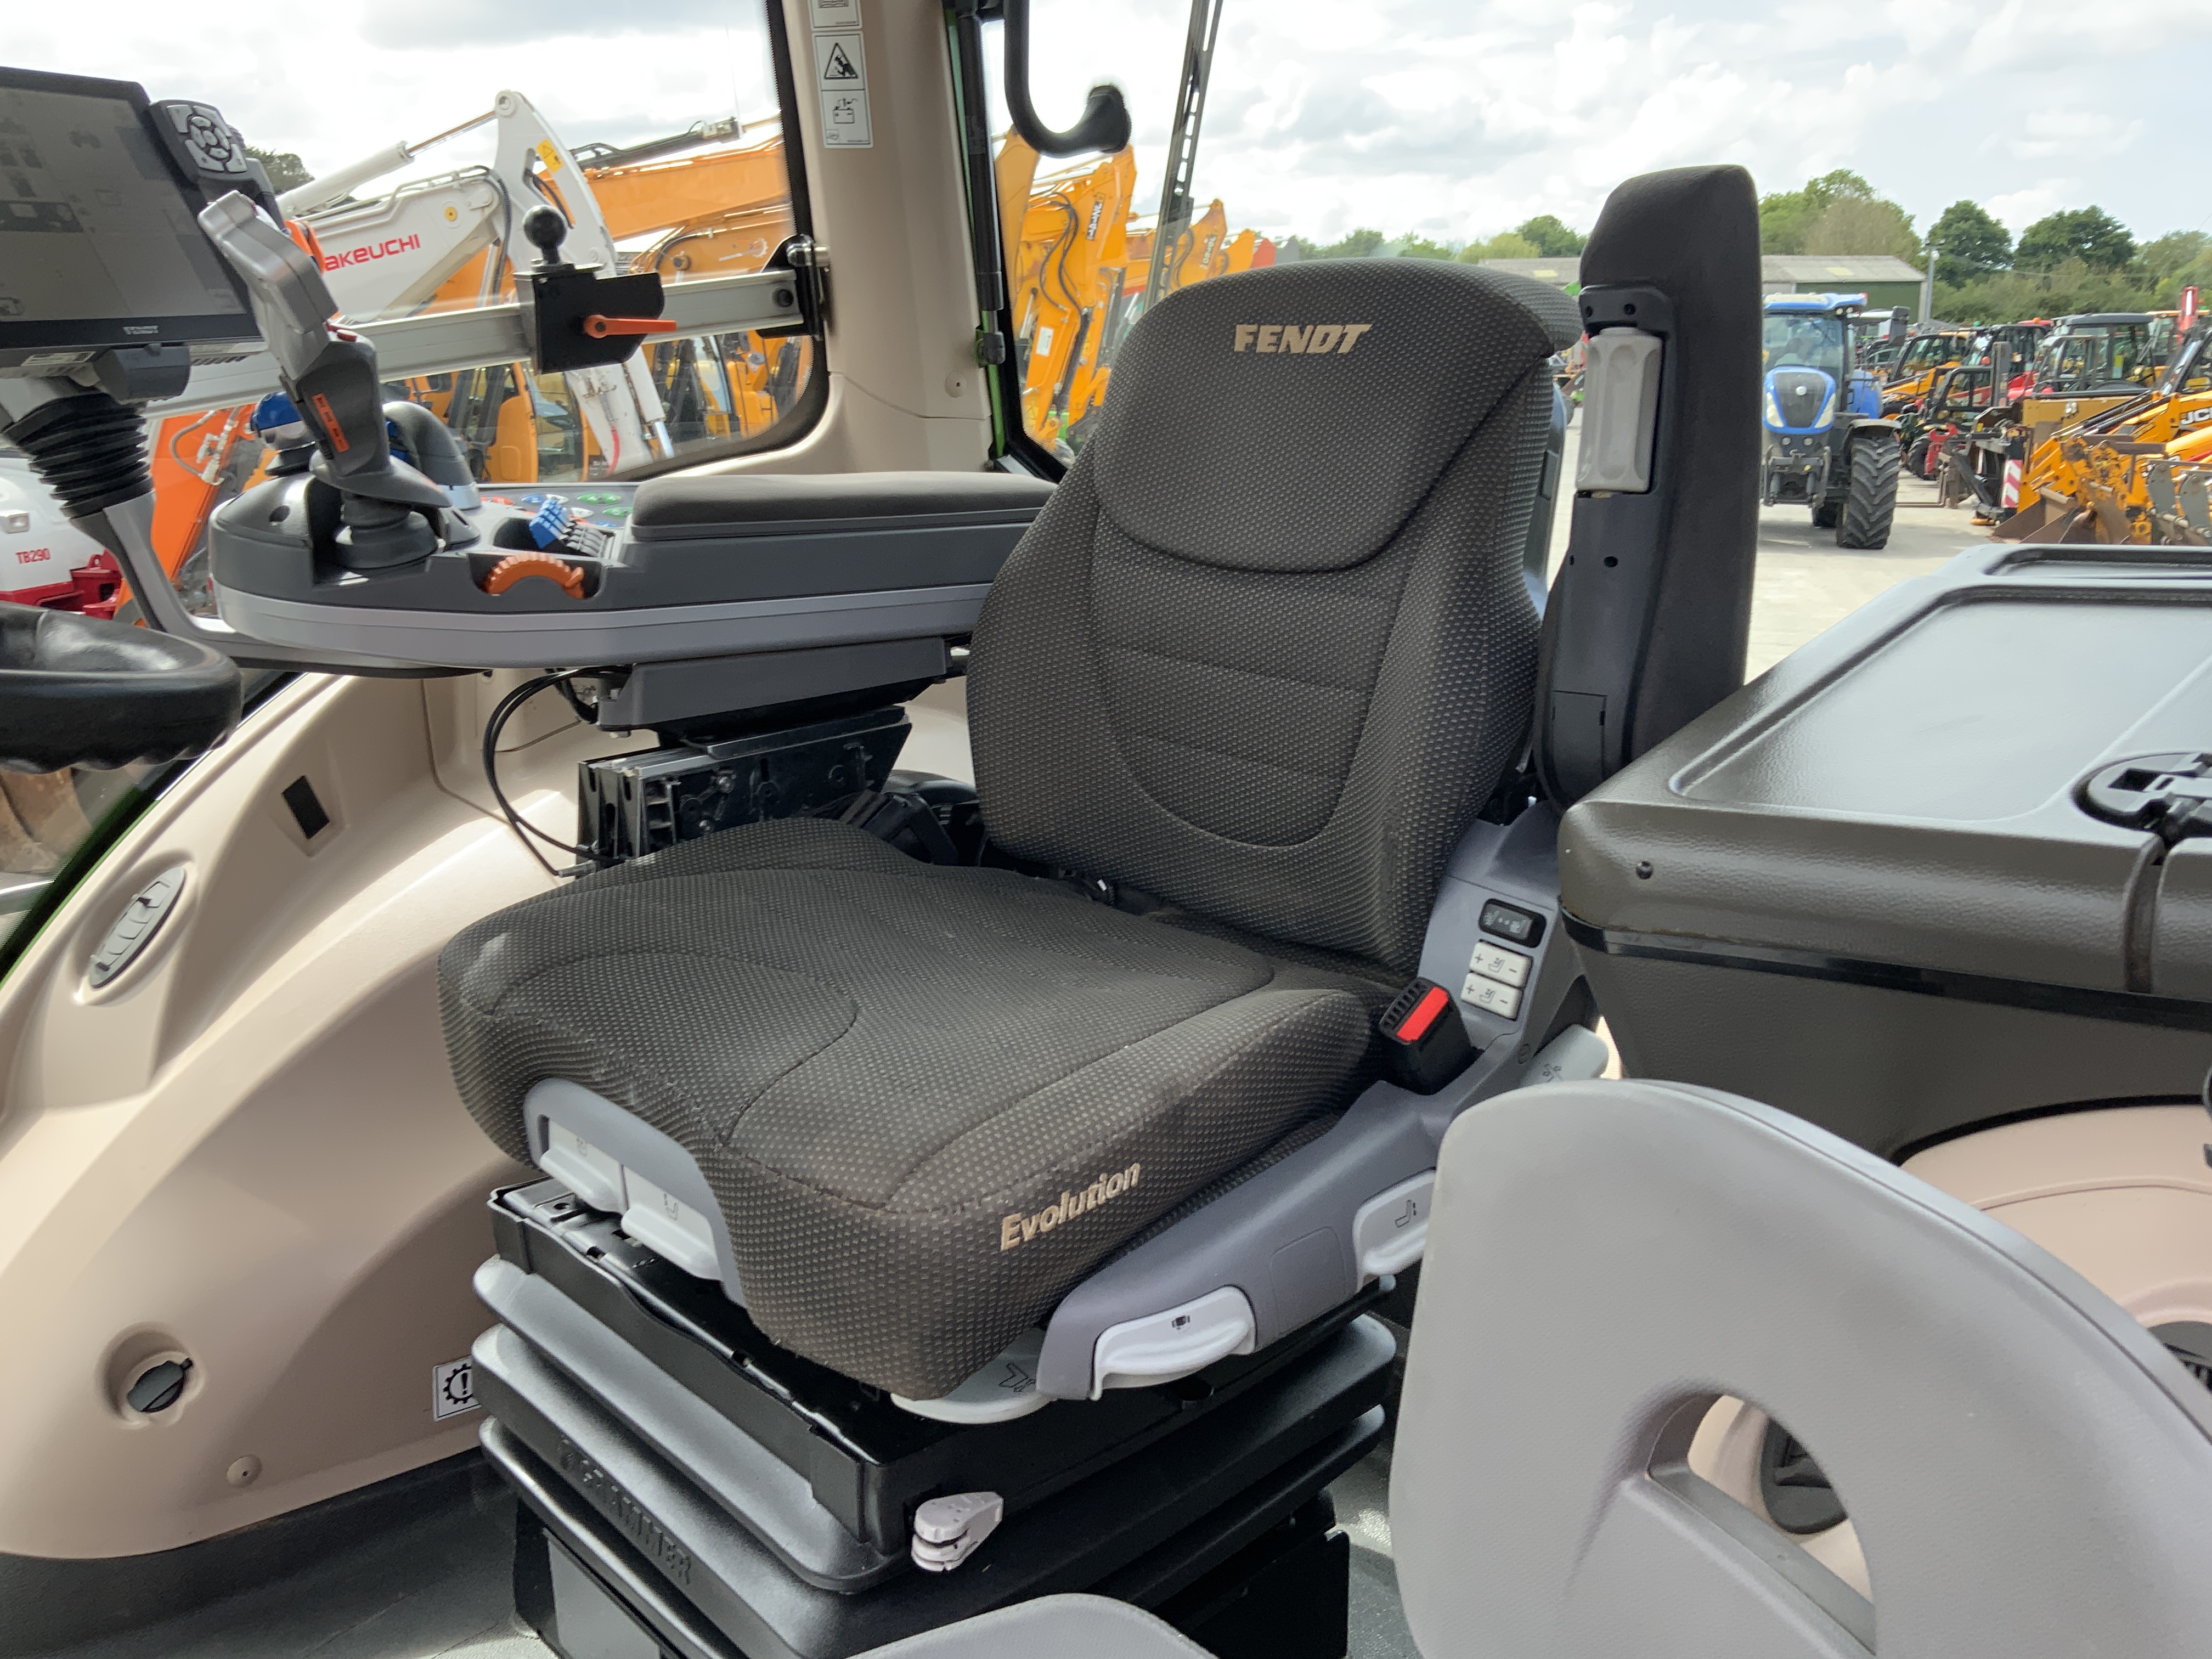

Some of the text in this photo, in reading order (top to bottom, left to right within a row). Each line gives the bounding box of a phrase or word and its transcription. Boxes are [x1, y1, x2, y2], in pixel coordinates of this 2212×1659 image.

[1234, 324, 1373, 354] FENDT
[2181, 408, 2212, 425] JC
[15, 548, 51, 564] TB290
[1000, 1162, 1141, 1251] Evolution
